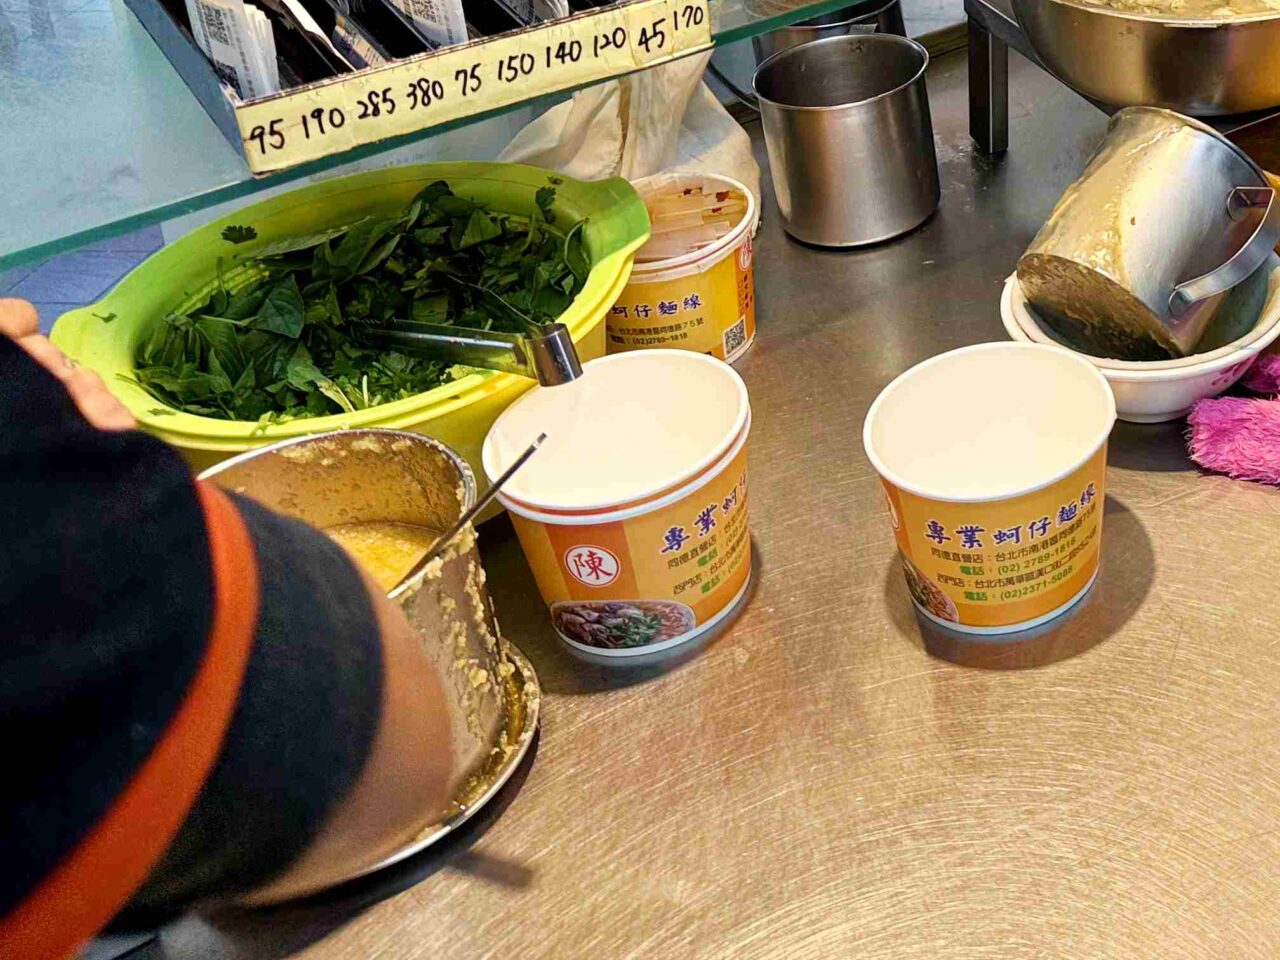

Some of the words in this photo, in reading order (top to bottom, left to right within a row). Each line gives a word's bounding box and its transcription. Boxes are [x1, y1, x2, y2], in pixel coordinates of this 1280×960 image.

[250, 118, 285, 154] 95
[302, 108, 344, 139] 190
[357, 88, 396, 119] 285
[407, 78, 444, 110] 380
[455, 63, 482, 96] 75
[498, 53, 535, 82] 150
[546, 41, 582, 68] 140
[594, 27, 626, 57] 120
[638, 18, 666, 53] 45
[673, 5, 704, 31] 170
[611, 294, 702, 318] 蚵仔麵線
[925, 483, 1095, 549] 專業蚵仔麵線
[573, 551, 613, 580] 陳
